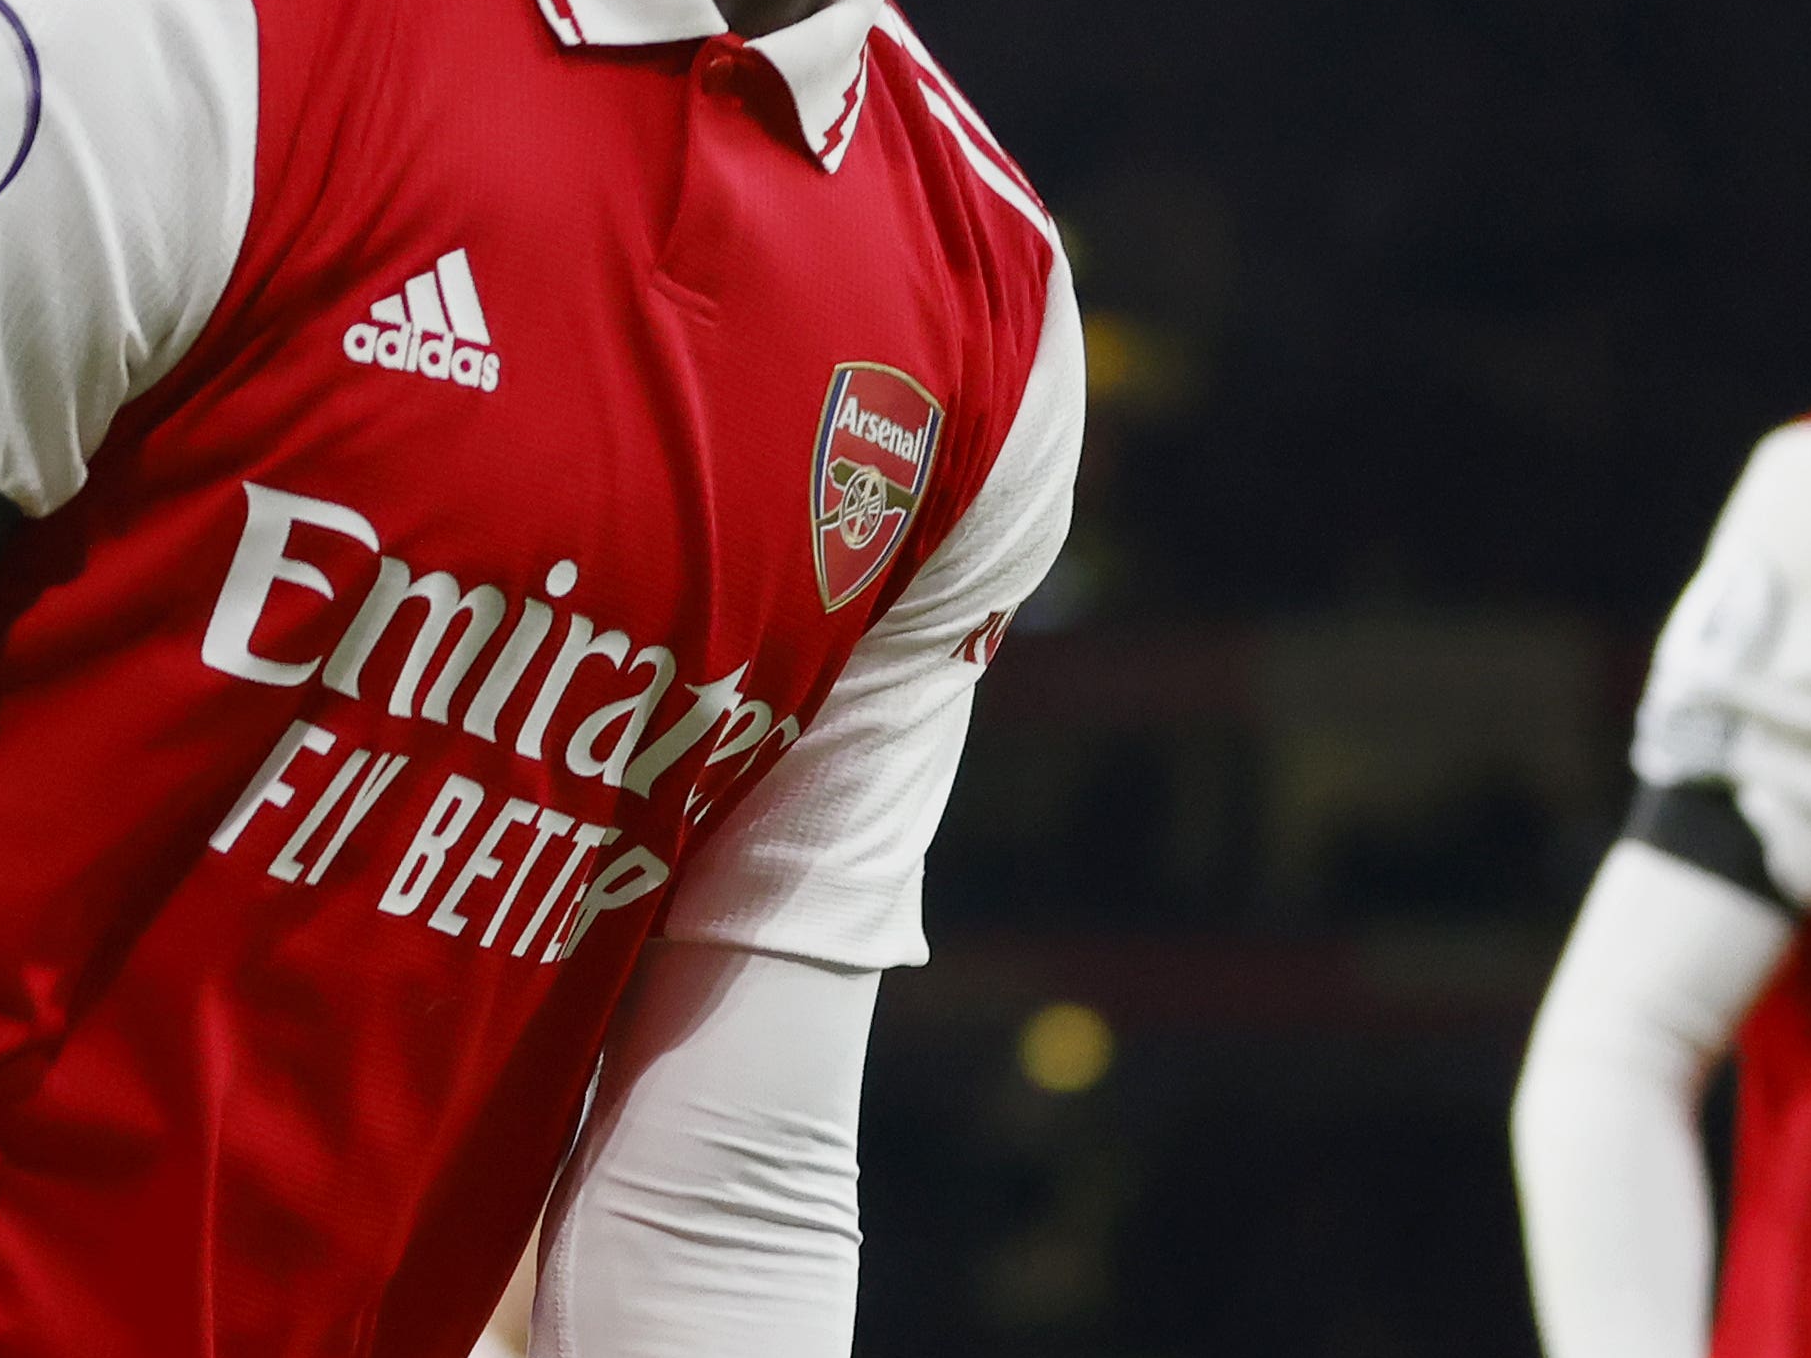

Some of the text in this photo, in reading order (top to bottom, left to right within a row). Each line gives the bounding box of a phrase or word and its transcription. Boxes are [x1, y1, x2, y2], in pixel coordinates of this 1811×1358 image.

[343, 322, 501, 393] adidas
[837, 396, 925, 464] Arsenal
[209, 718, 410, 887] FLY
